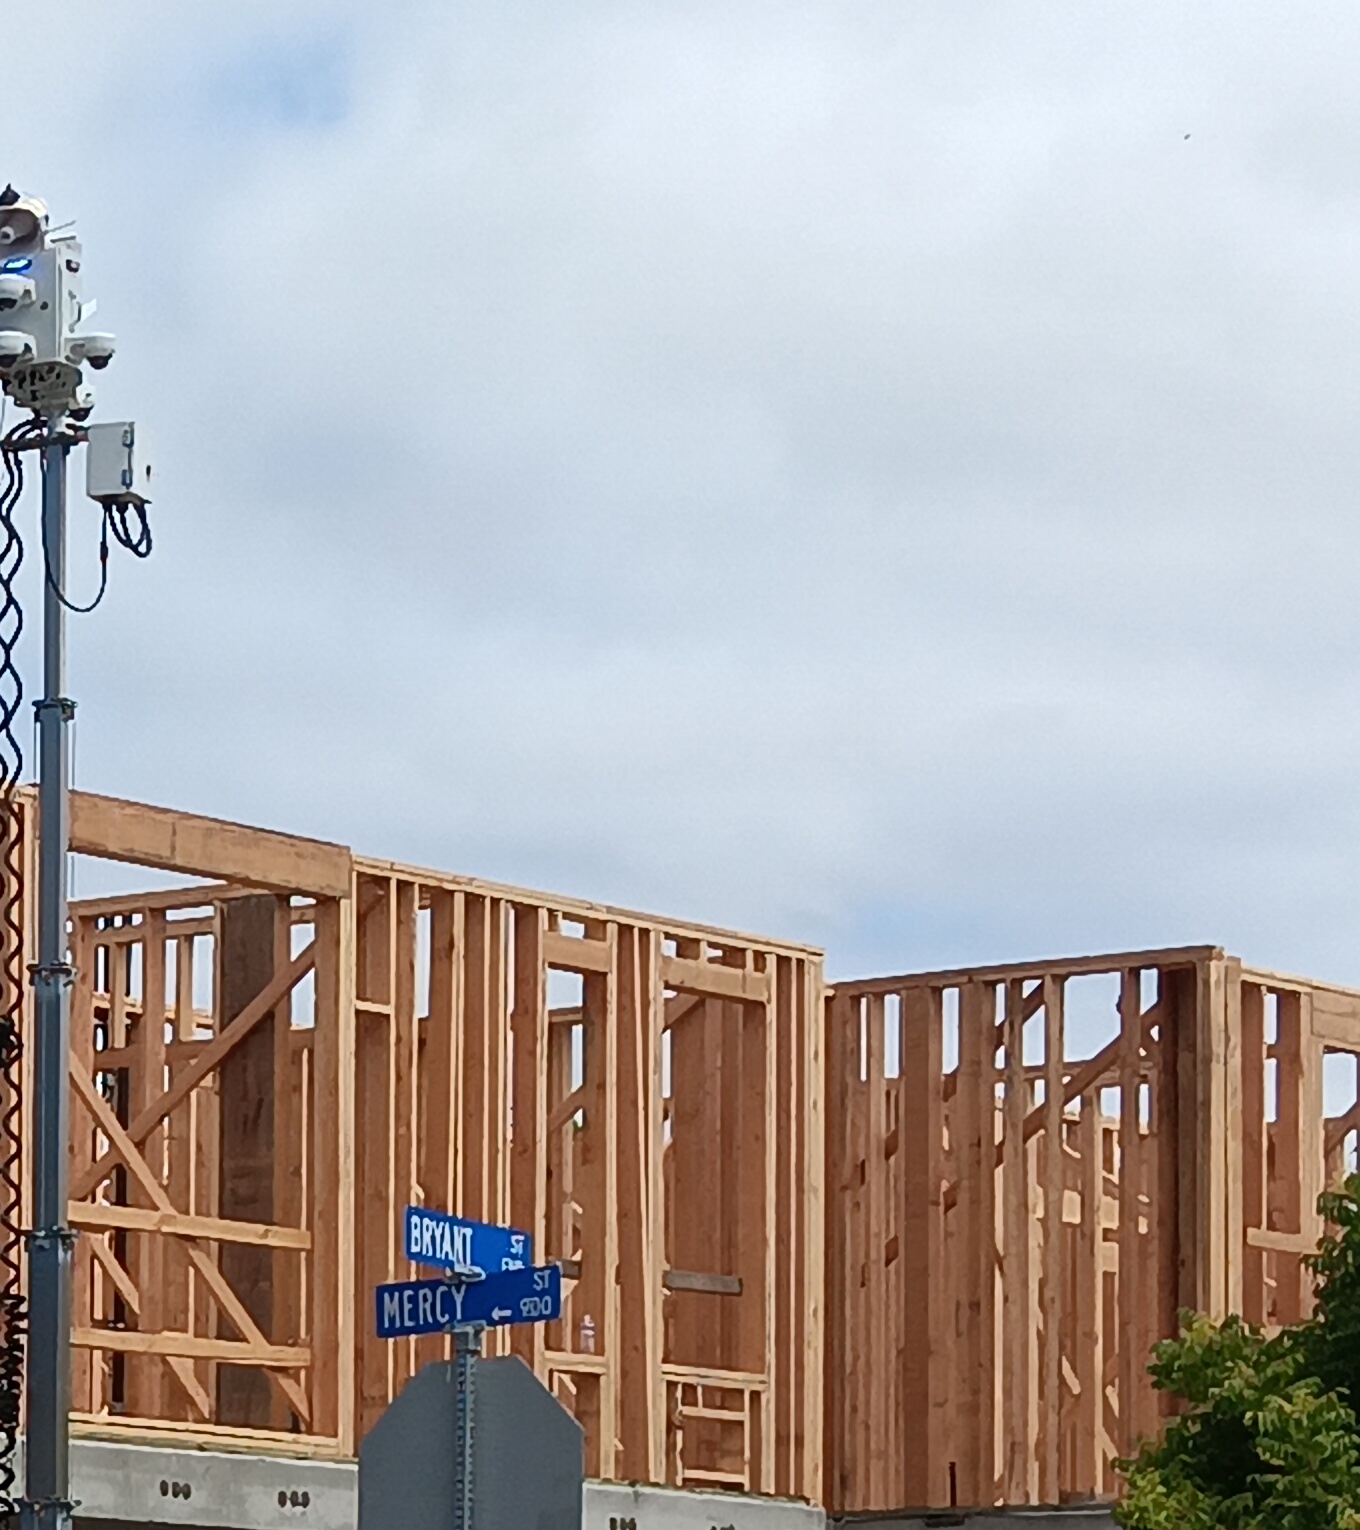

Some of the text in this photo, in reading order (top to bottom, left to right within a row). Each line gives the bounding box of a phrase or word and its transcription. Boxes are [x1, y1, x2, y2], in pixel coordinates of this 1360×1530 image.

[410, 1215, 473, 1267] BRYANT
[383, 1269, 551, 1329] MERCY ST
